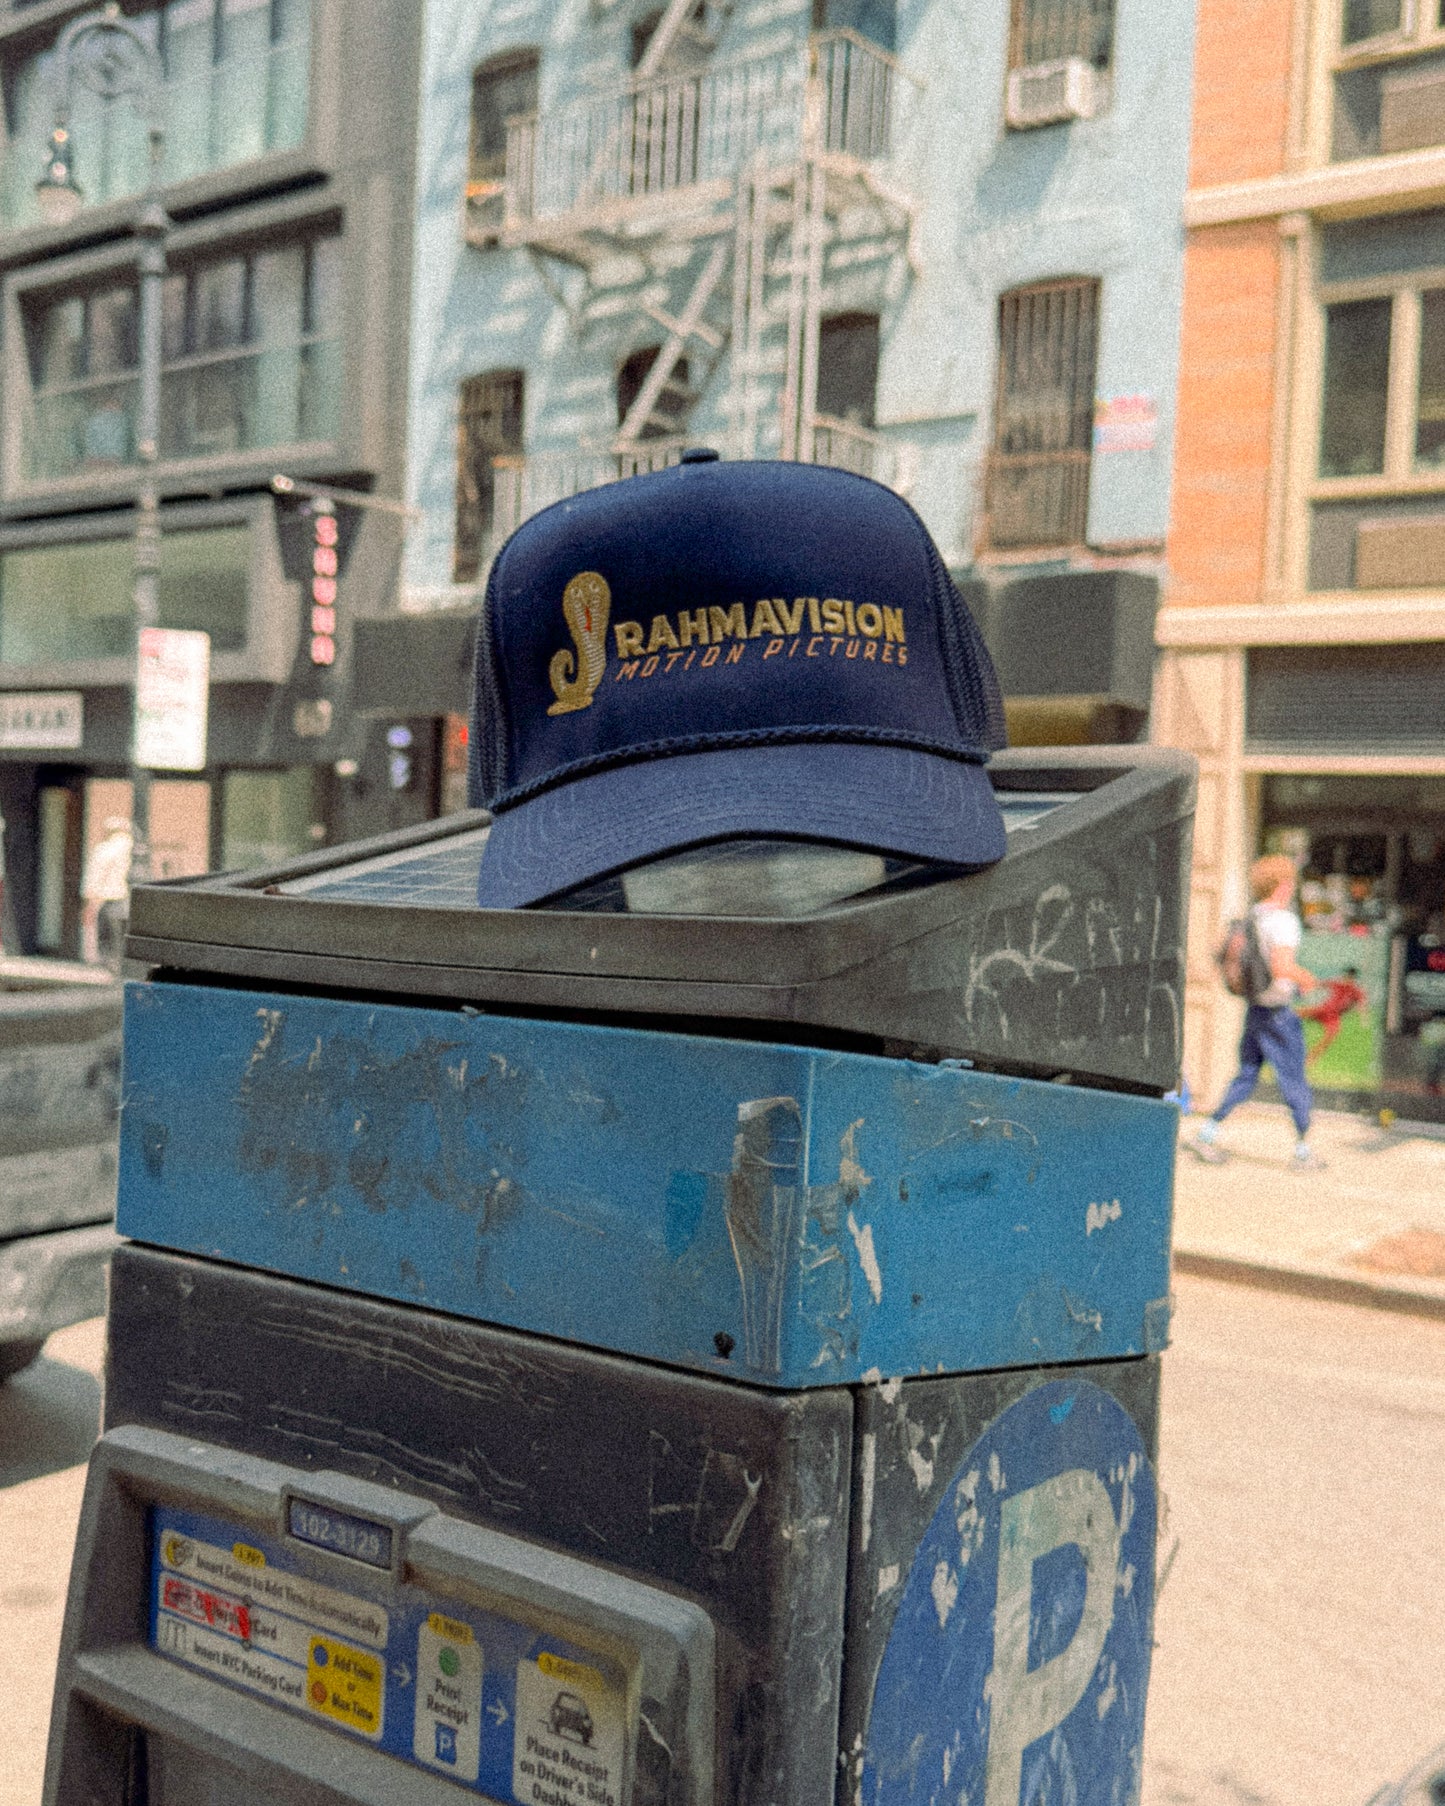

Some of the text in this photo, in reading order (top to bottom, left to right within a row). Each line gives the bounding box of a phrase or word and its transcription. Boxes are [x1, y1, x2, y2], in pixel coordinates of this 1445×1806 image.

[614, 598, 905, 659] RAHMAVISION
[615, 637, 908, 682] MOTION PICTURES
[985, 1469, 1121, 1806] P
[242, 1660, 278, 1690] Parking
[278, 1675, 302, 1698] Card
[435, 1677, 463, 1702] Print
[426, 1694, 470, 1725] Receipt
[520, 1760, 536, 1775] on
[526, 1735, 609, 1781] Place Receipt
